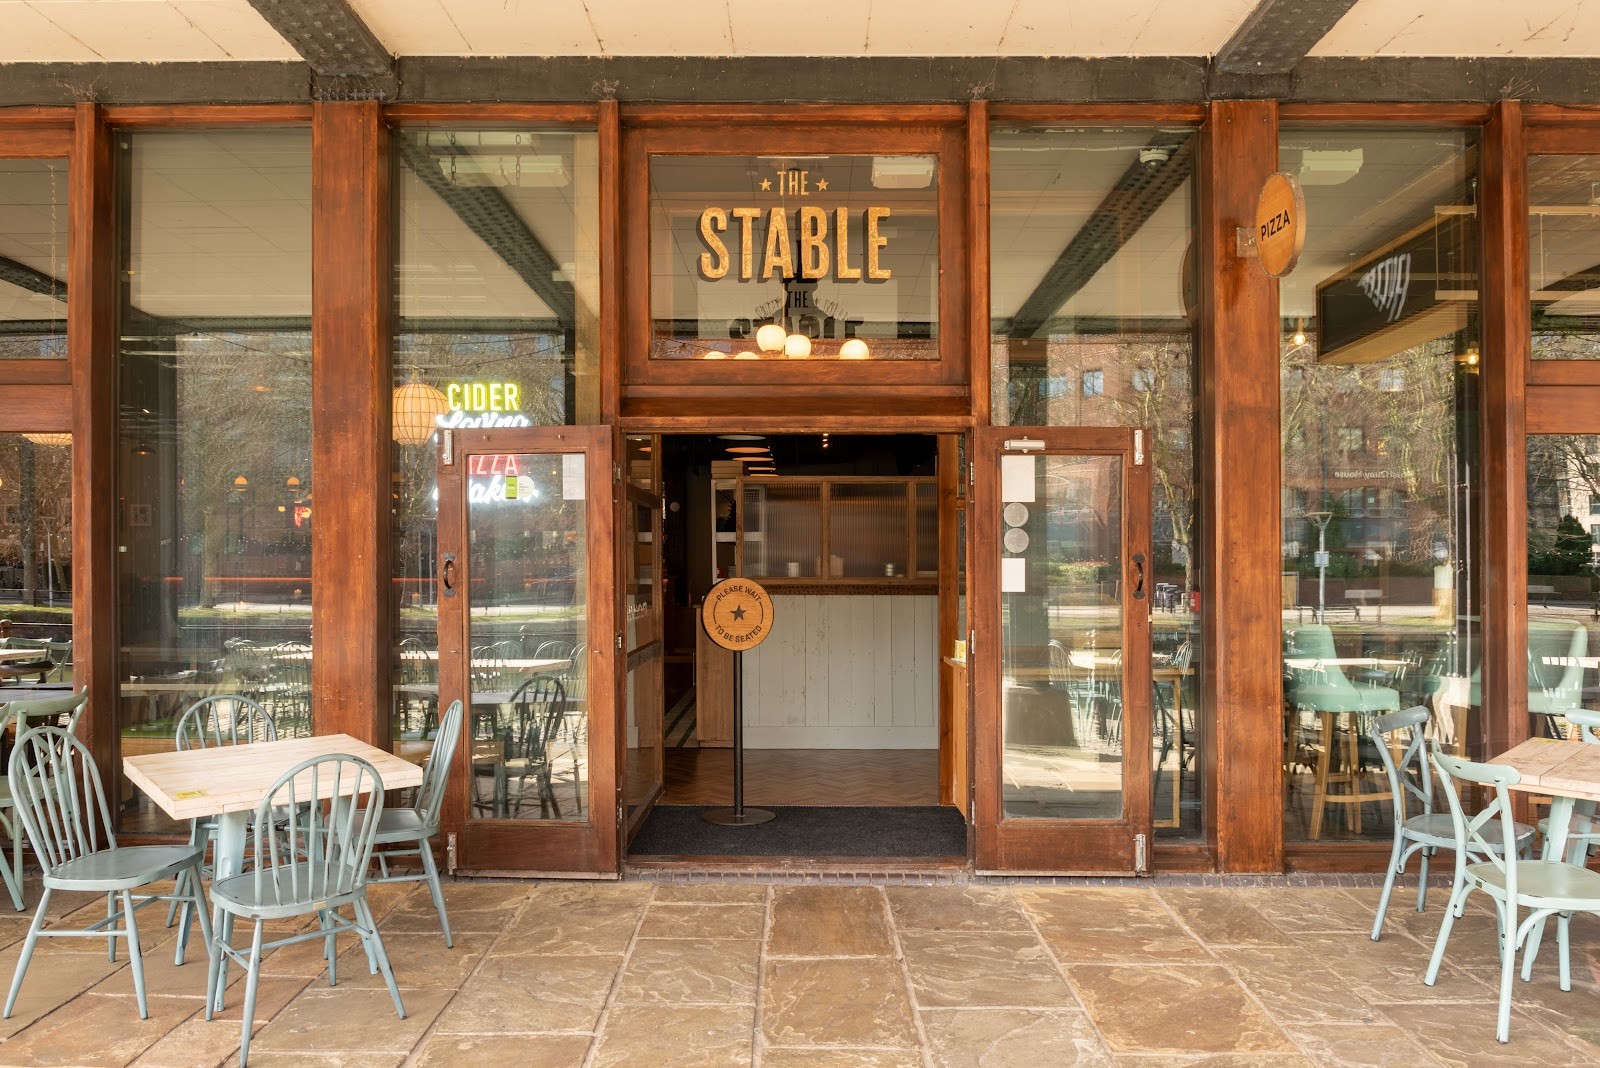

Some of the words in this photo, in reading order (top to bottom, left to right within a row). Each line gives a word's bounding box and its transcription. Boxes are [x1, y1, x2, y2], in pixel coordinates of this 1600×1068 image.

[777, 171, 809, 195] THE
[1260, 210, 1291, 242] PIZZA
[697, 206, 892, 283] STABLE
[788, 290, 809, 308] THE
[447, 383, 519, 412] CIDER
[468, 454, 519, 475] IZZA
[716, 585, 744, 601] PLEASE
[744, 586, 762, 602] WAIT
[715, 624, 725, 636] TO
[723, 632, 734, 642] BE
[735, 625, 762, 643] SEATED
